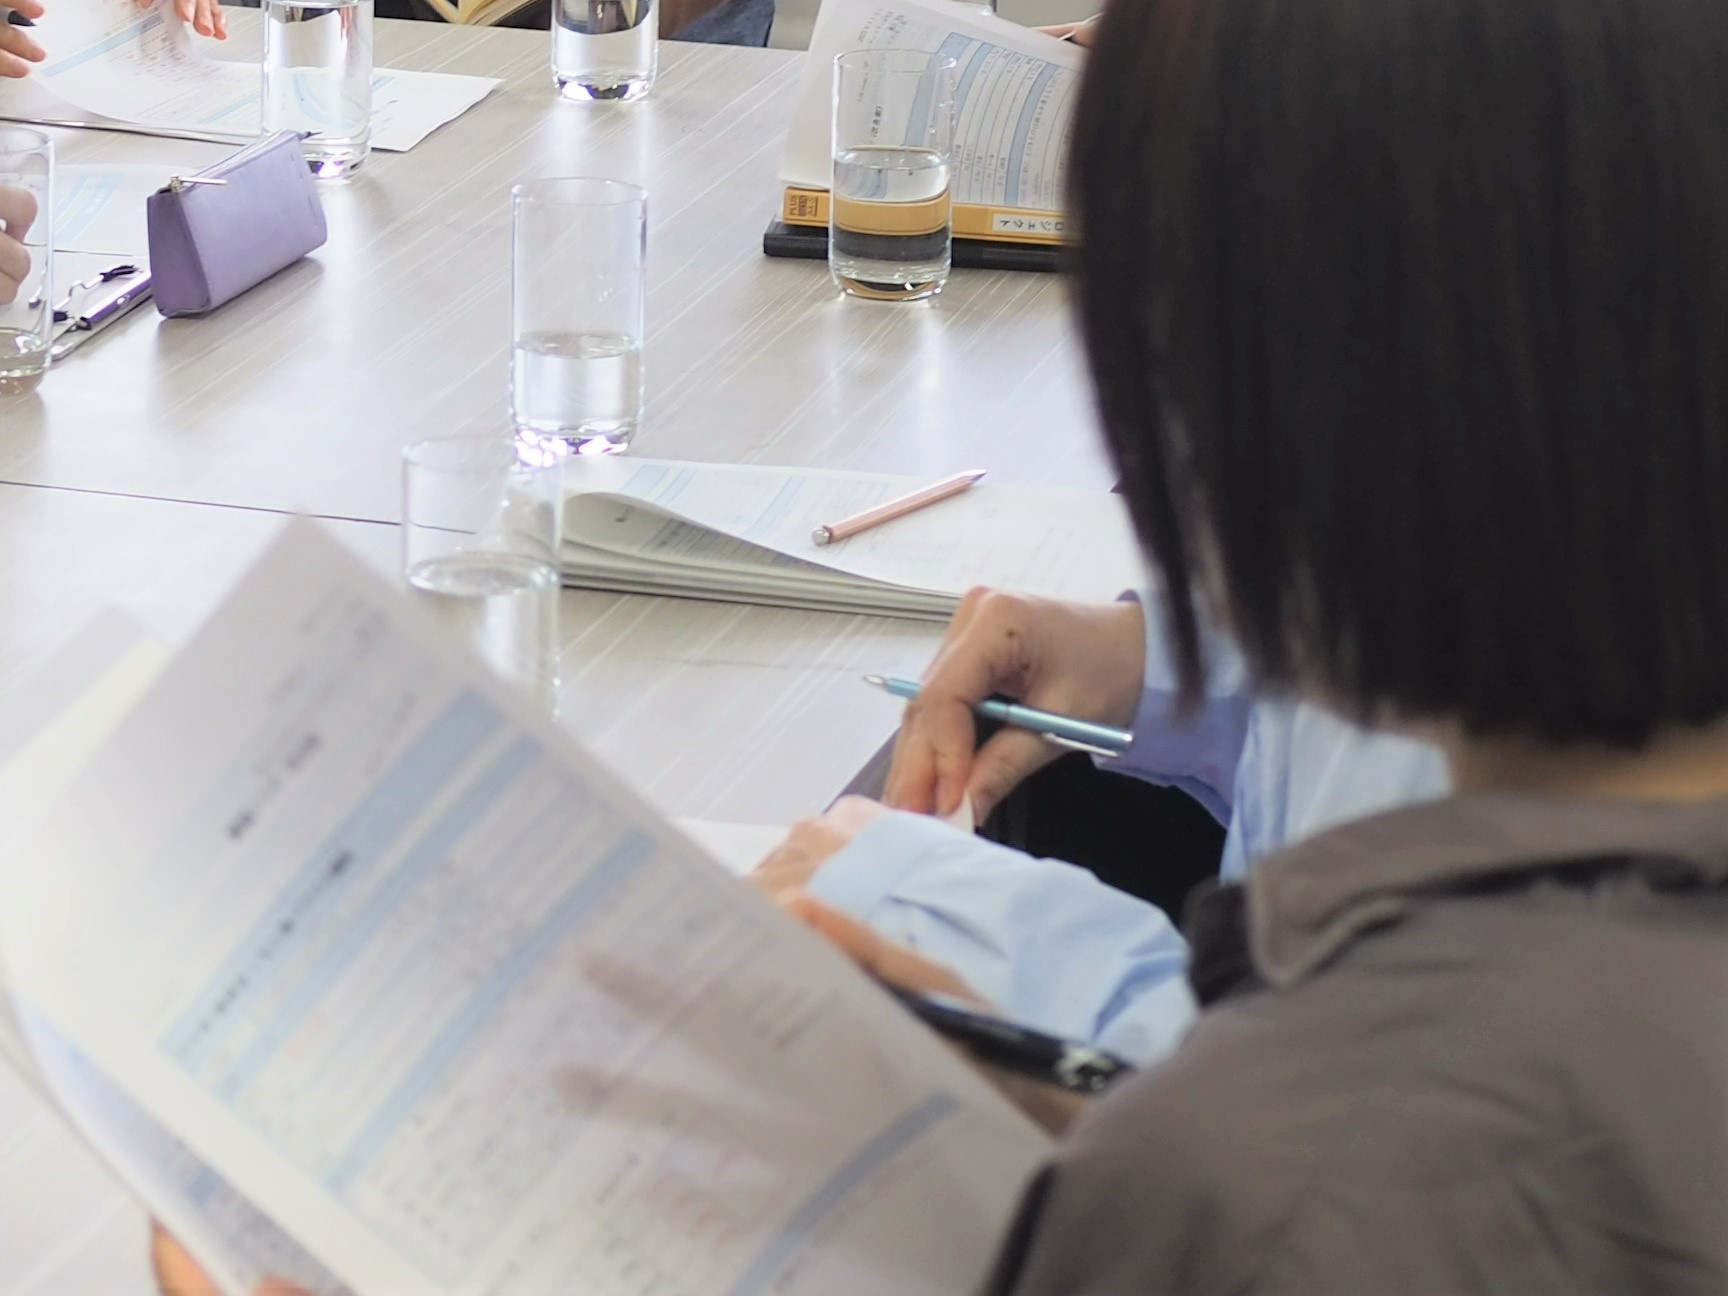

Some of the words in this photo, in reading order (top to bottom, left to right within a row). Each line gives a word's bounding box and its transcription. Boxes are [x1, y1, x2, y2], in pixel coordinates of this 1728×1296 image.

[1000, 219, 1065, 232] ロジェクト
